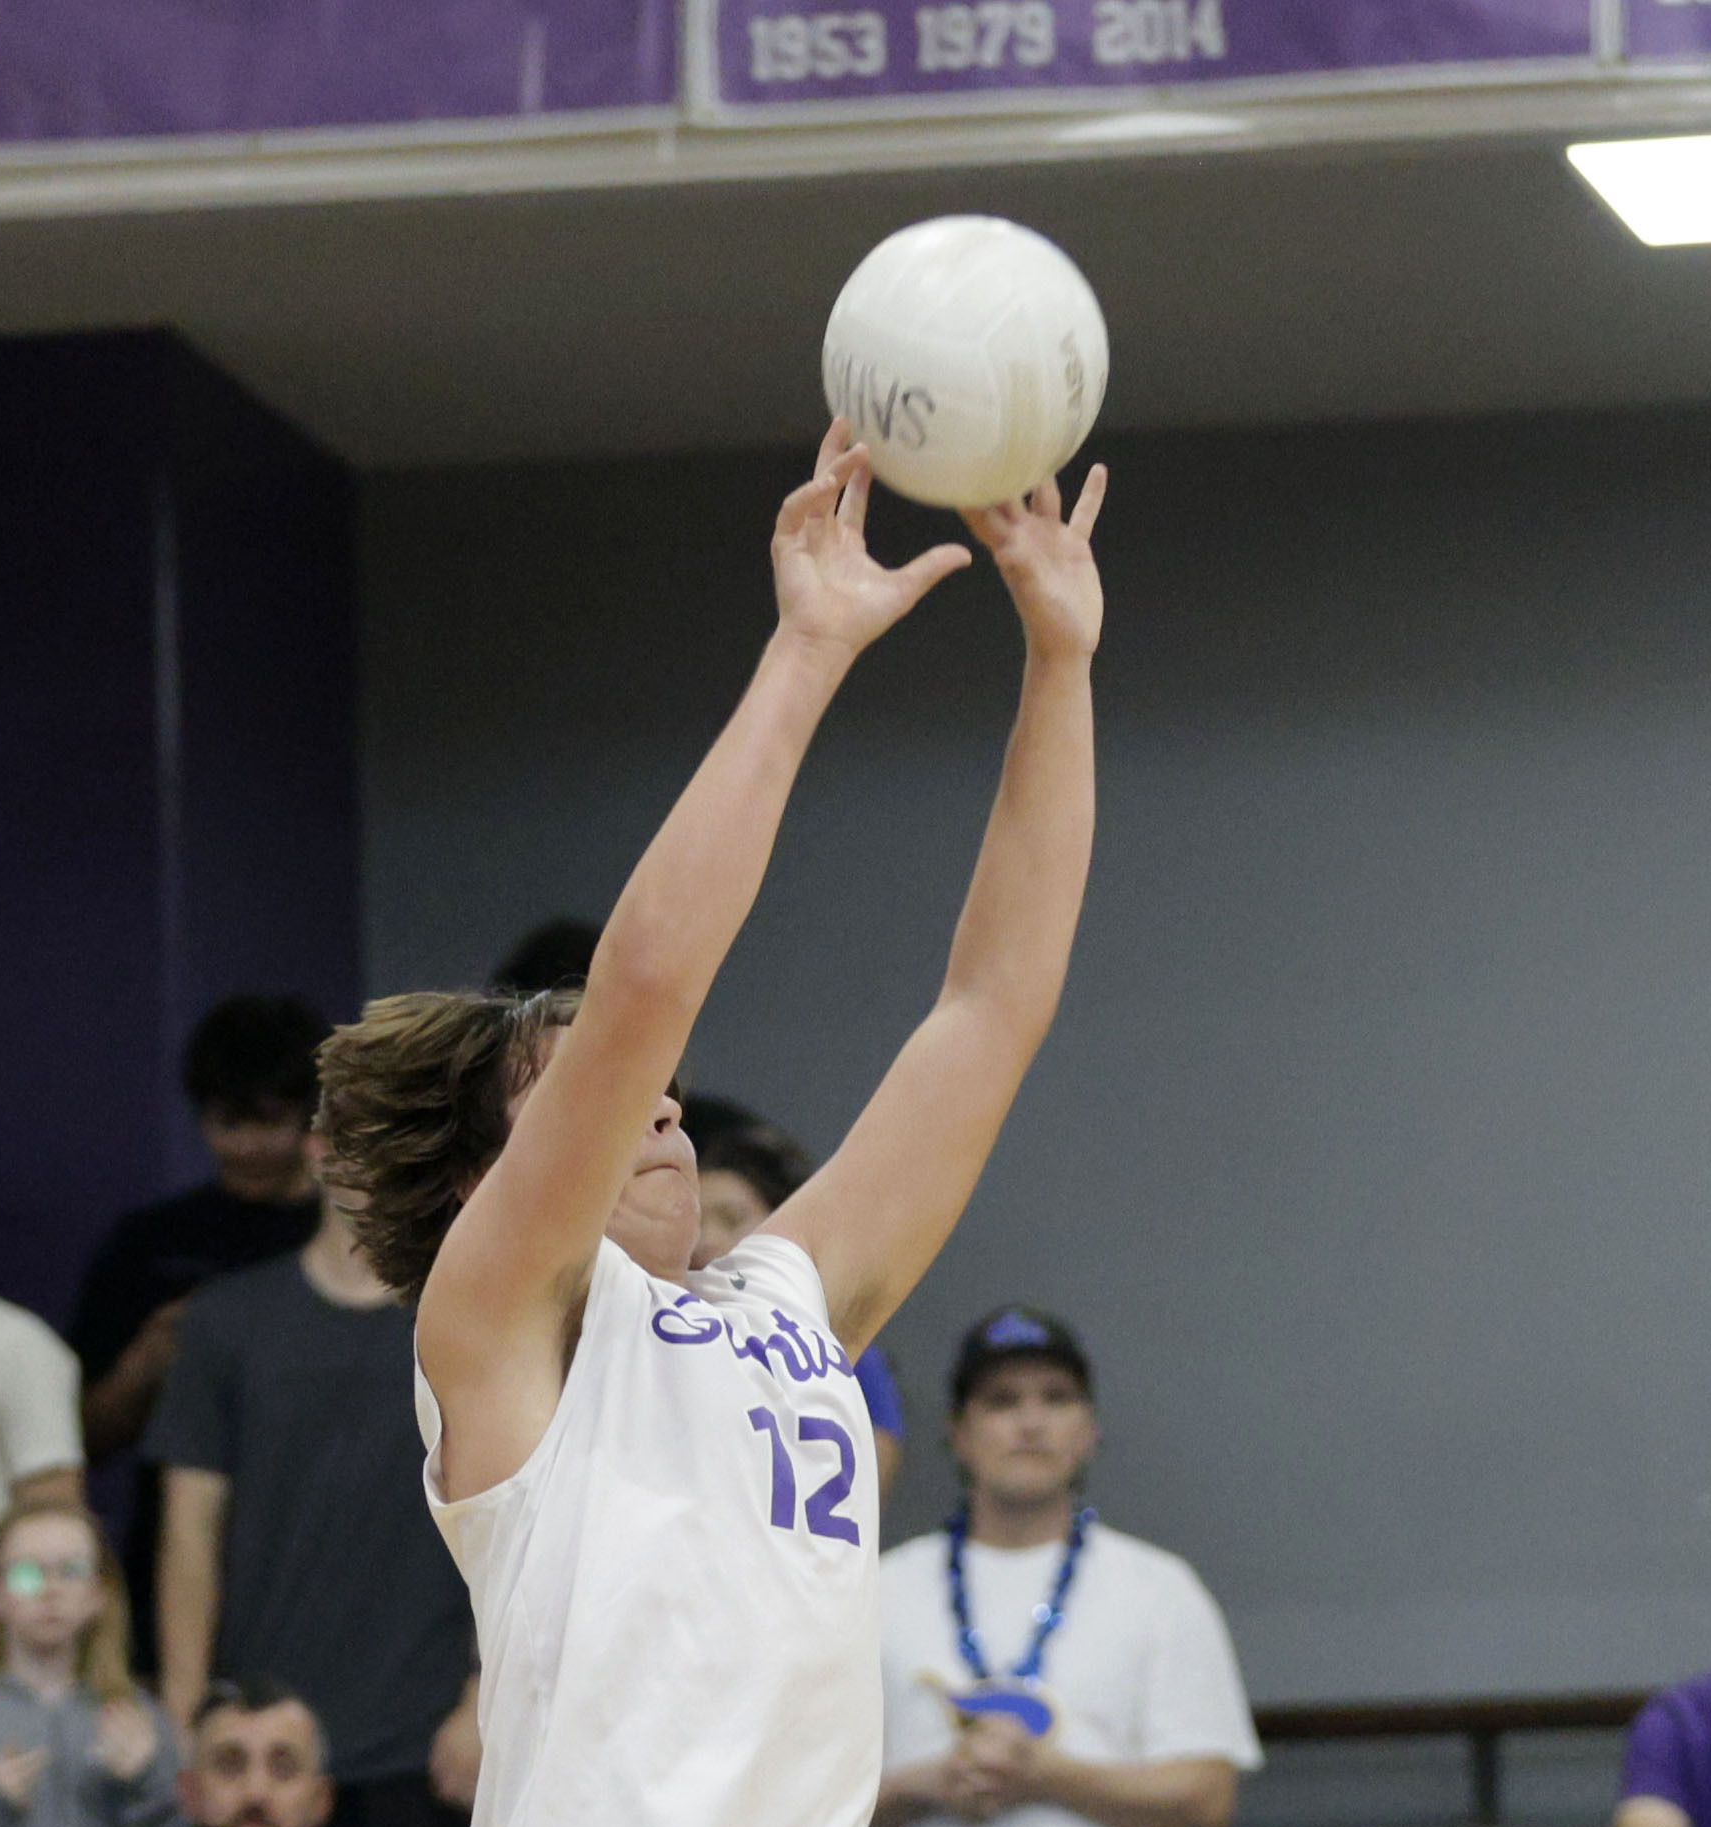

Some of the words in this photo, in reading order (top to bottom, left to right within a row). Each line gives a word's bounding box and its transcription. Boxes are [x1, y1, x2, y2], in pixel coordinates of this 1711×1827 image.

[748, 11, 887, 82] 1953
[915, 3, 1054, 71] 1979
[1091, 0, 1225, 64] 2014
[747, 1406, 860, 1548] 12
